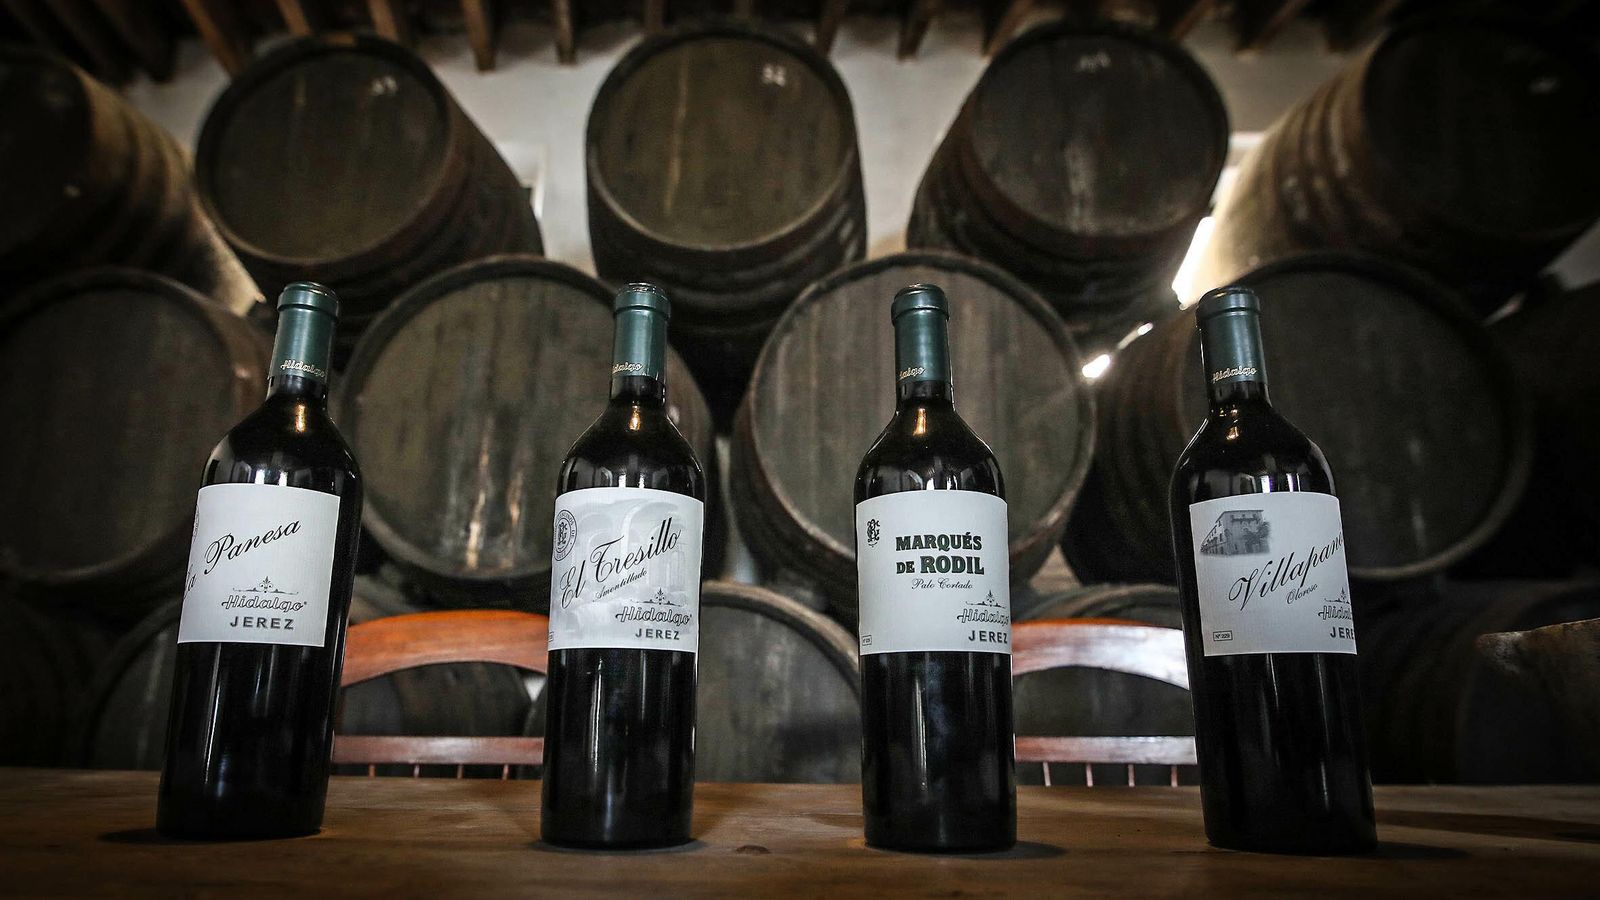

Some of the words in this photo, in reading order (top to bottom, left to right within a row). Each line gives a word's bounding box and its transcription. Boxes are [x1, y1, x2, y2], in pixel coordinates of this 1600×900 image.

[280, 359, 326, 378] Hidalgo
[1212, 365, 1257, 385] Hidalgo
[204, 520, 302, 575] Panesa
[895, 532, 983, 552] MARQUÉS
[560, 559, 587, 609] El
[590, 516, 682, 583] Tresillo
[896, 561, 916, 575] DE
[920, 555, 985, 575] RODIL
[911, 578, 936, 590] Palo
[937, 577, 973, 590] Cortado
[221, 594, 304, 613] Hidalgo
[1286, 584, 1318, 605] Oloroso
[230, 616, 295, 630] JEREZ
[615, 605, 690, 626] Hidalgo
[635, 628, 680, 641] JEREZ
[968, 630, 1008, 644] JEREZ
[1330, 626, 1354, 640] JERE
